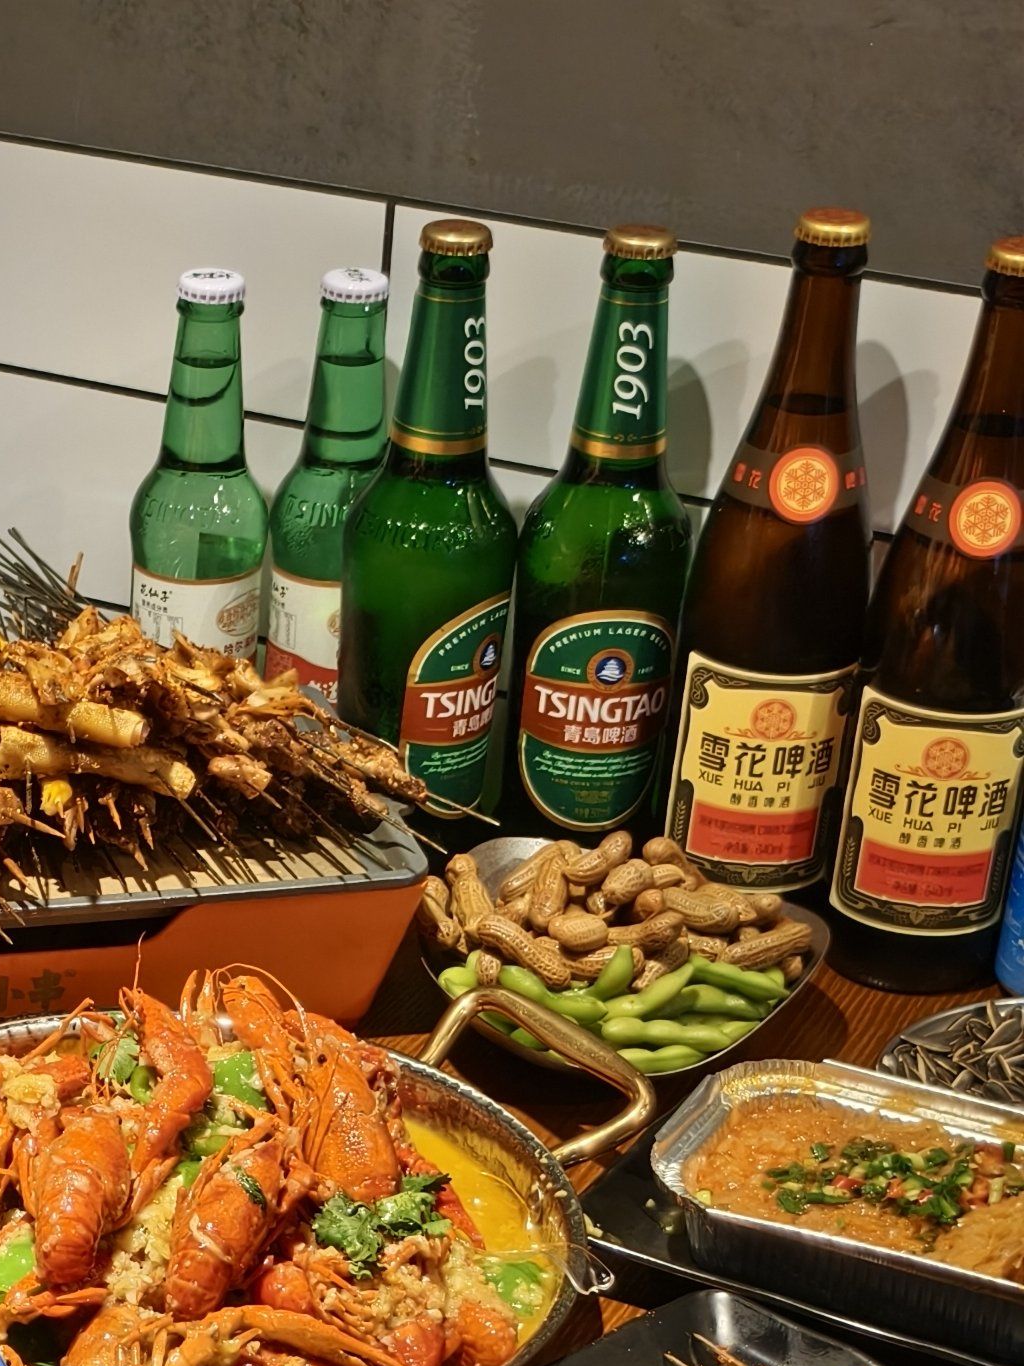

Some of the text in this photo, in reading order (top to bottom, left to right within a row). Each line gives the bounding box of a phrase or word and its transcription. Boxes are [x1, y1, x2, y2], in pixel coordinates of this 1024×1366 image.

[464, 316, 487, 410] 1903
[612, 321, 653, 420] 1903
[438, 619, 486, 656] PREMIUM
[549, 628, 602, 653] PREMIUM
[608, 627, 646, 637] LAGER
[560, 665, 581, 675] SINCE
[534, 685, 665, 723] TSINGTAO
[563, 724, 638, 745] 青島啤酒
[699, 731, 835, 779] 雪花啤酒
[698, 769, 826, 792] XUE HUA PI JIU
[869, 767, 1011, 820] 雪花啤酒
[868, 805, 1000, 833] XUE HUA PI JIU
